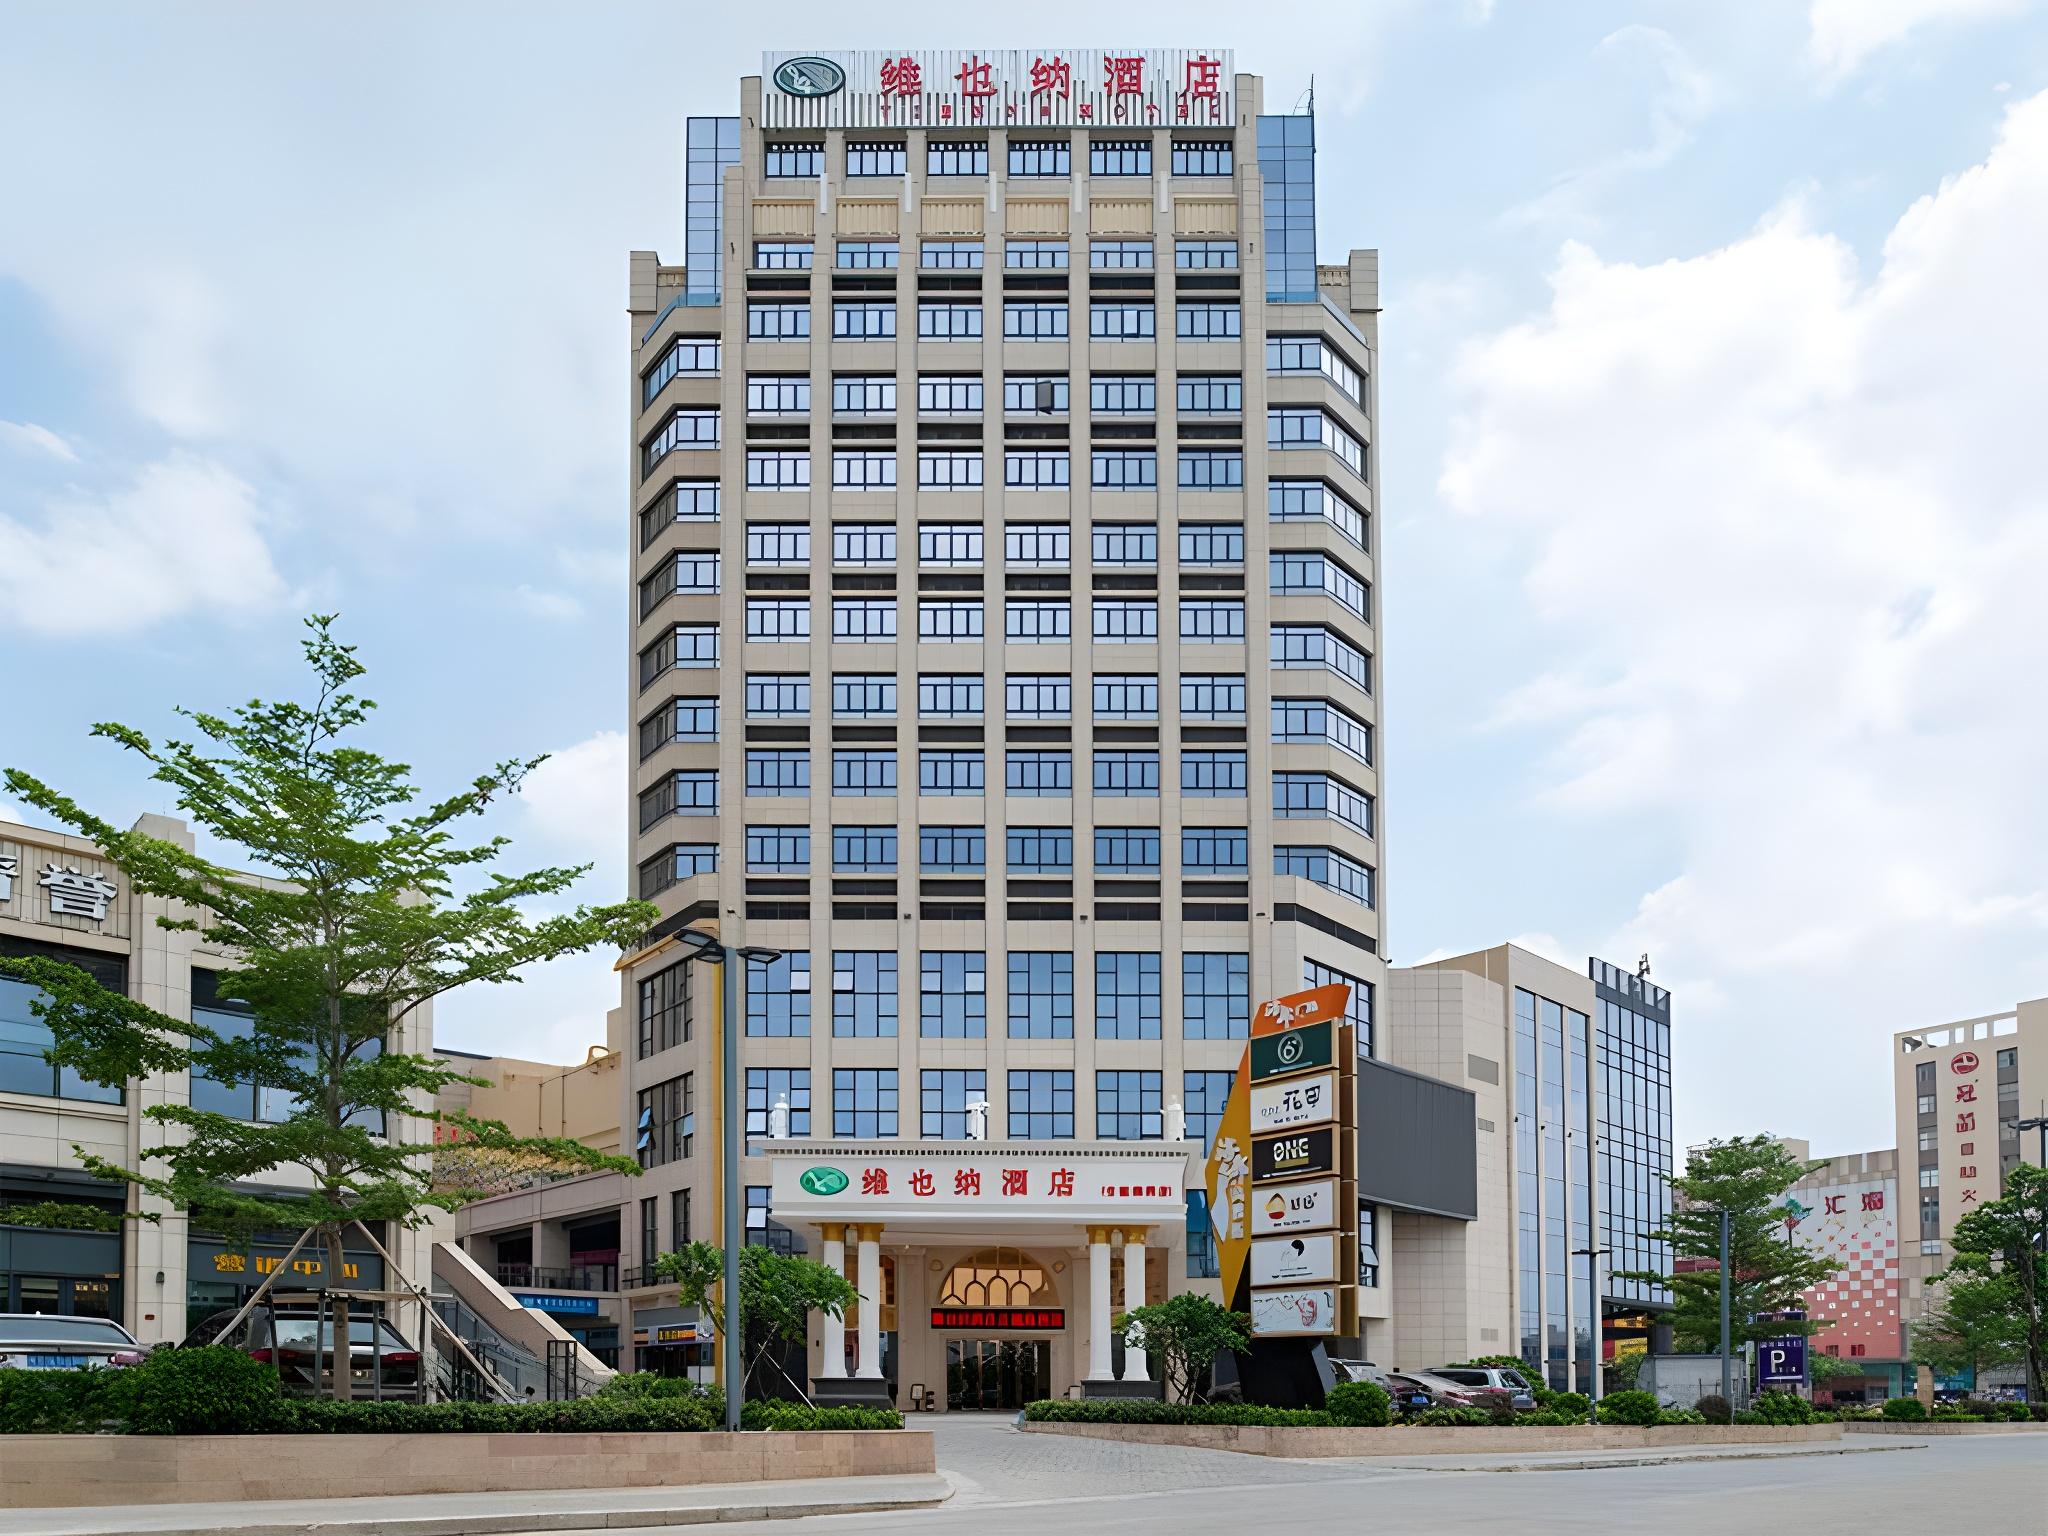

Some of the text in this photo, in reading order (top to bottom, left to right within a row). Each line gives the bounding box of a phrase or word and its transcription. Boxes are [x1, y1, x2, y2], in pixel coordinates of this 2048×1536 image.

[880, 55, 1222, 99] 维也纳酒店
[1273, 1138, 1309, 1162] ONE
[861, 1167, 1075, 1197] 维也纳酒店
[1770, 1349, 1786, 1374] P
